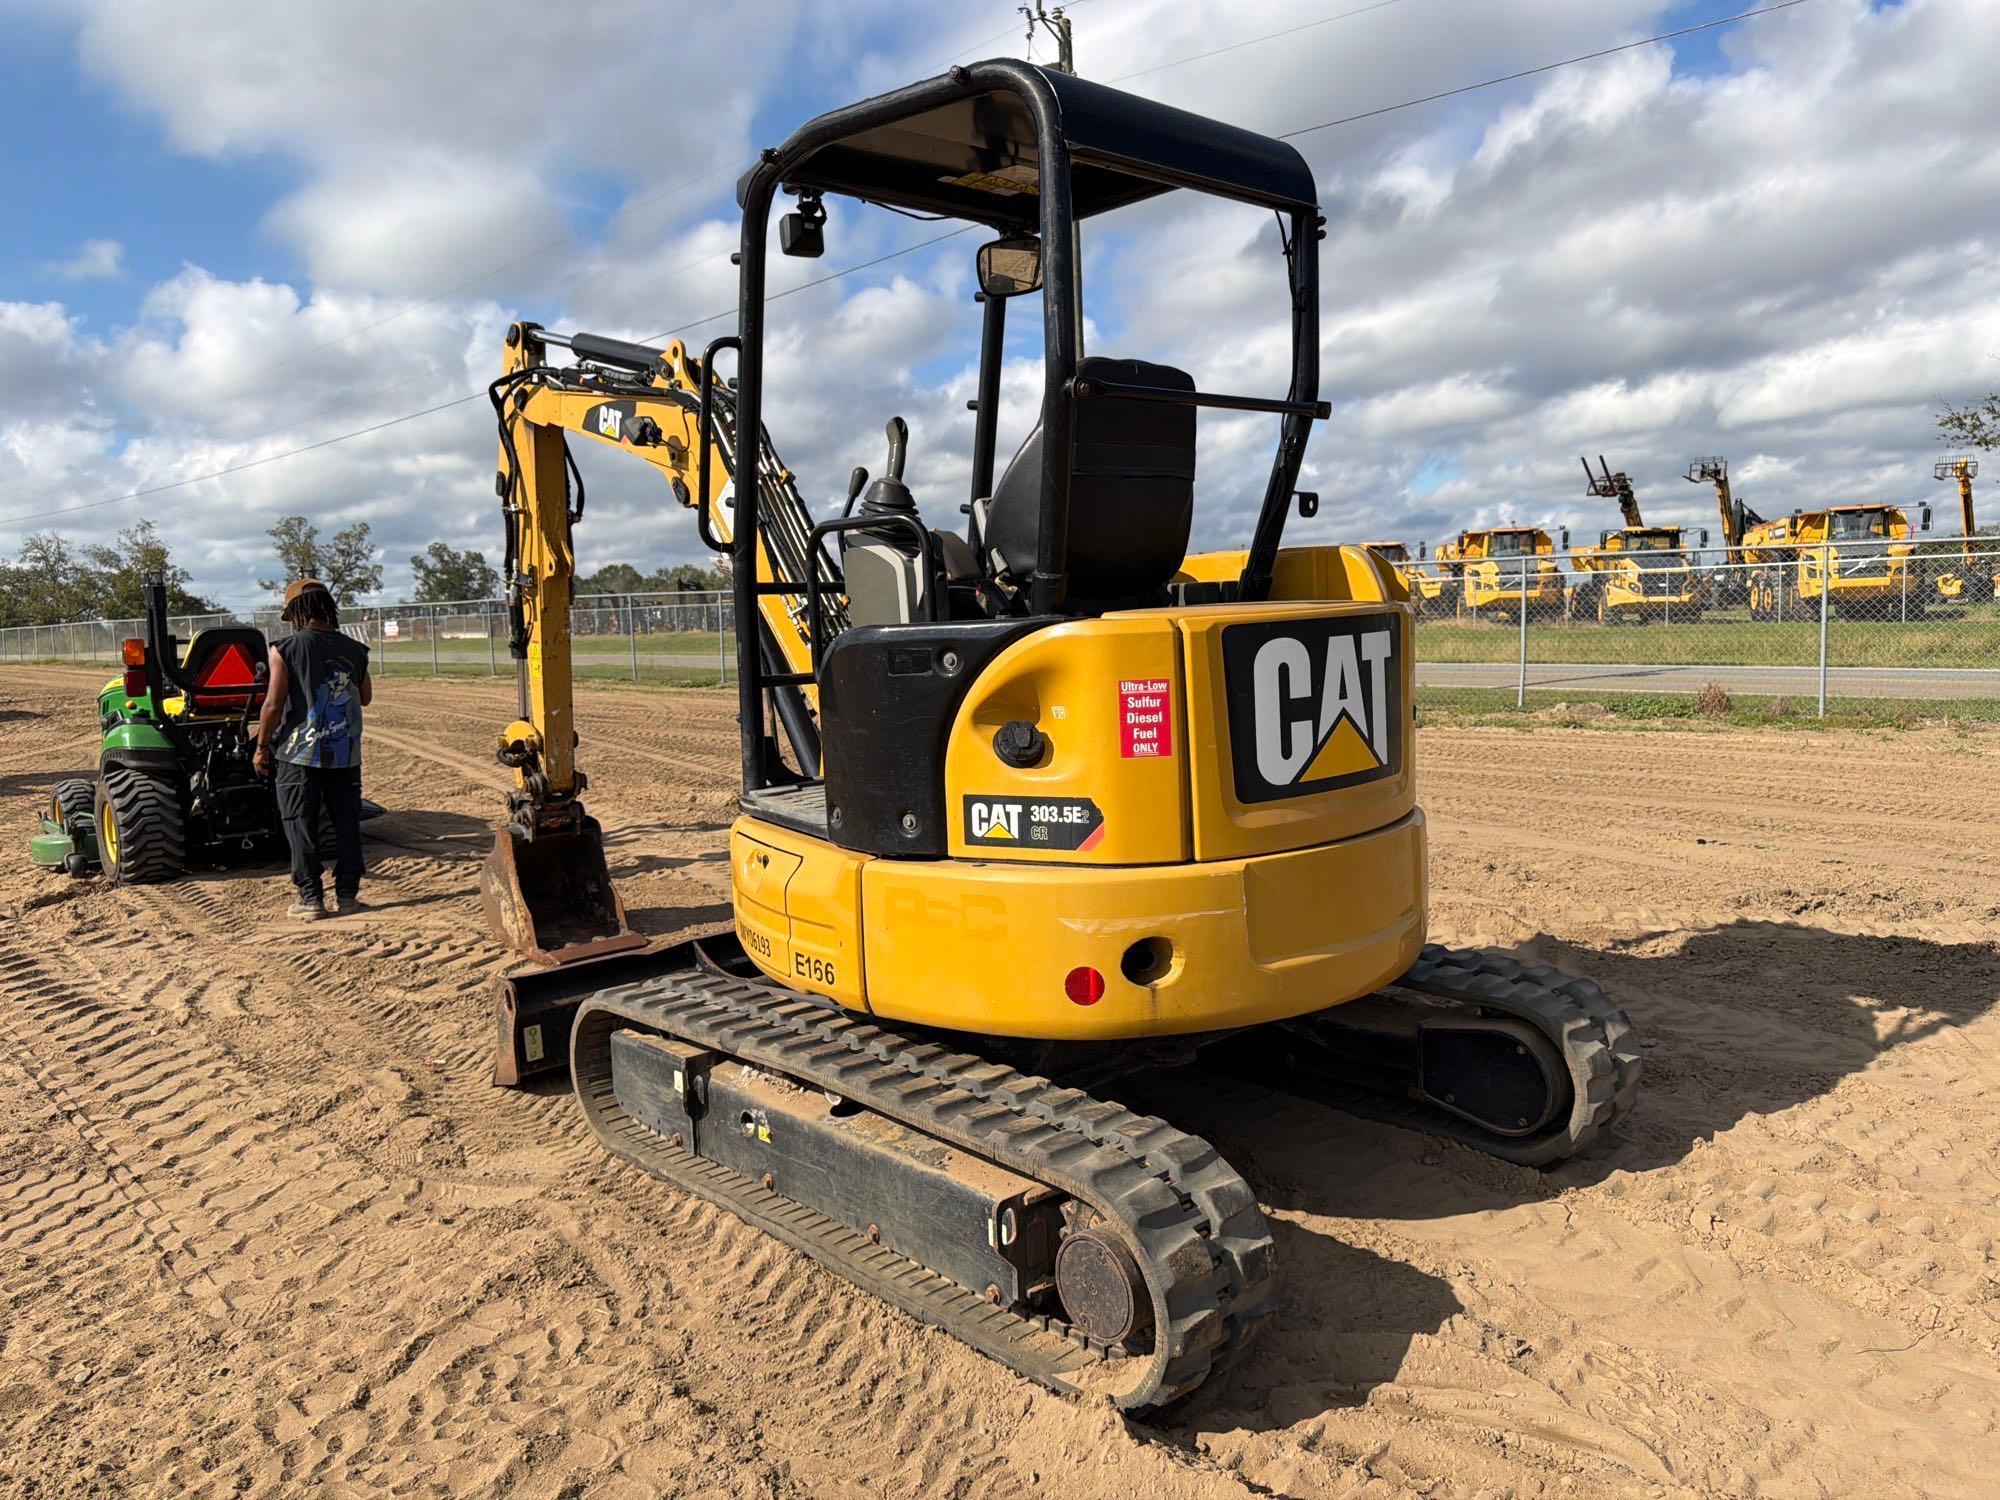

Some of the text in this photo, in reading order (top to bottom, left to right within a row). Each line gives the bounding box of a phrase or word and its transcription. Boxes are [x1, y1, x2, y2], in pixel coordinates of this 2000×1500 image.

[599, 405, 622, 439] CAT
[1121, 681, 1168, 692] Ultra-Low
[1127, 696, 1161, 708] Sulfur
[1253, 630, 1392, 786] CAT
[1126, 711, 1163, 724] Diesel
[1133, 727, 1157, 739] Fuel
[1133, 743, 1158, 753] ONLY
[971, 802, 1022, 839] CAT
[1030, 825, 1048, 840] CR
[794, 952, 835, 985] E166
